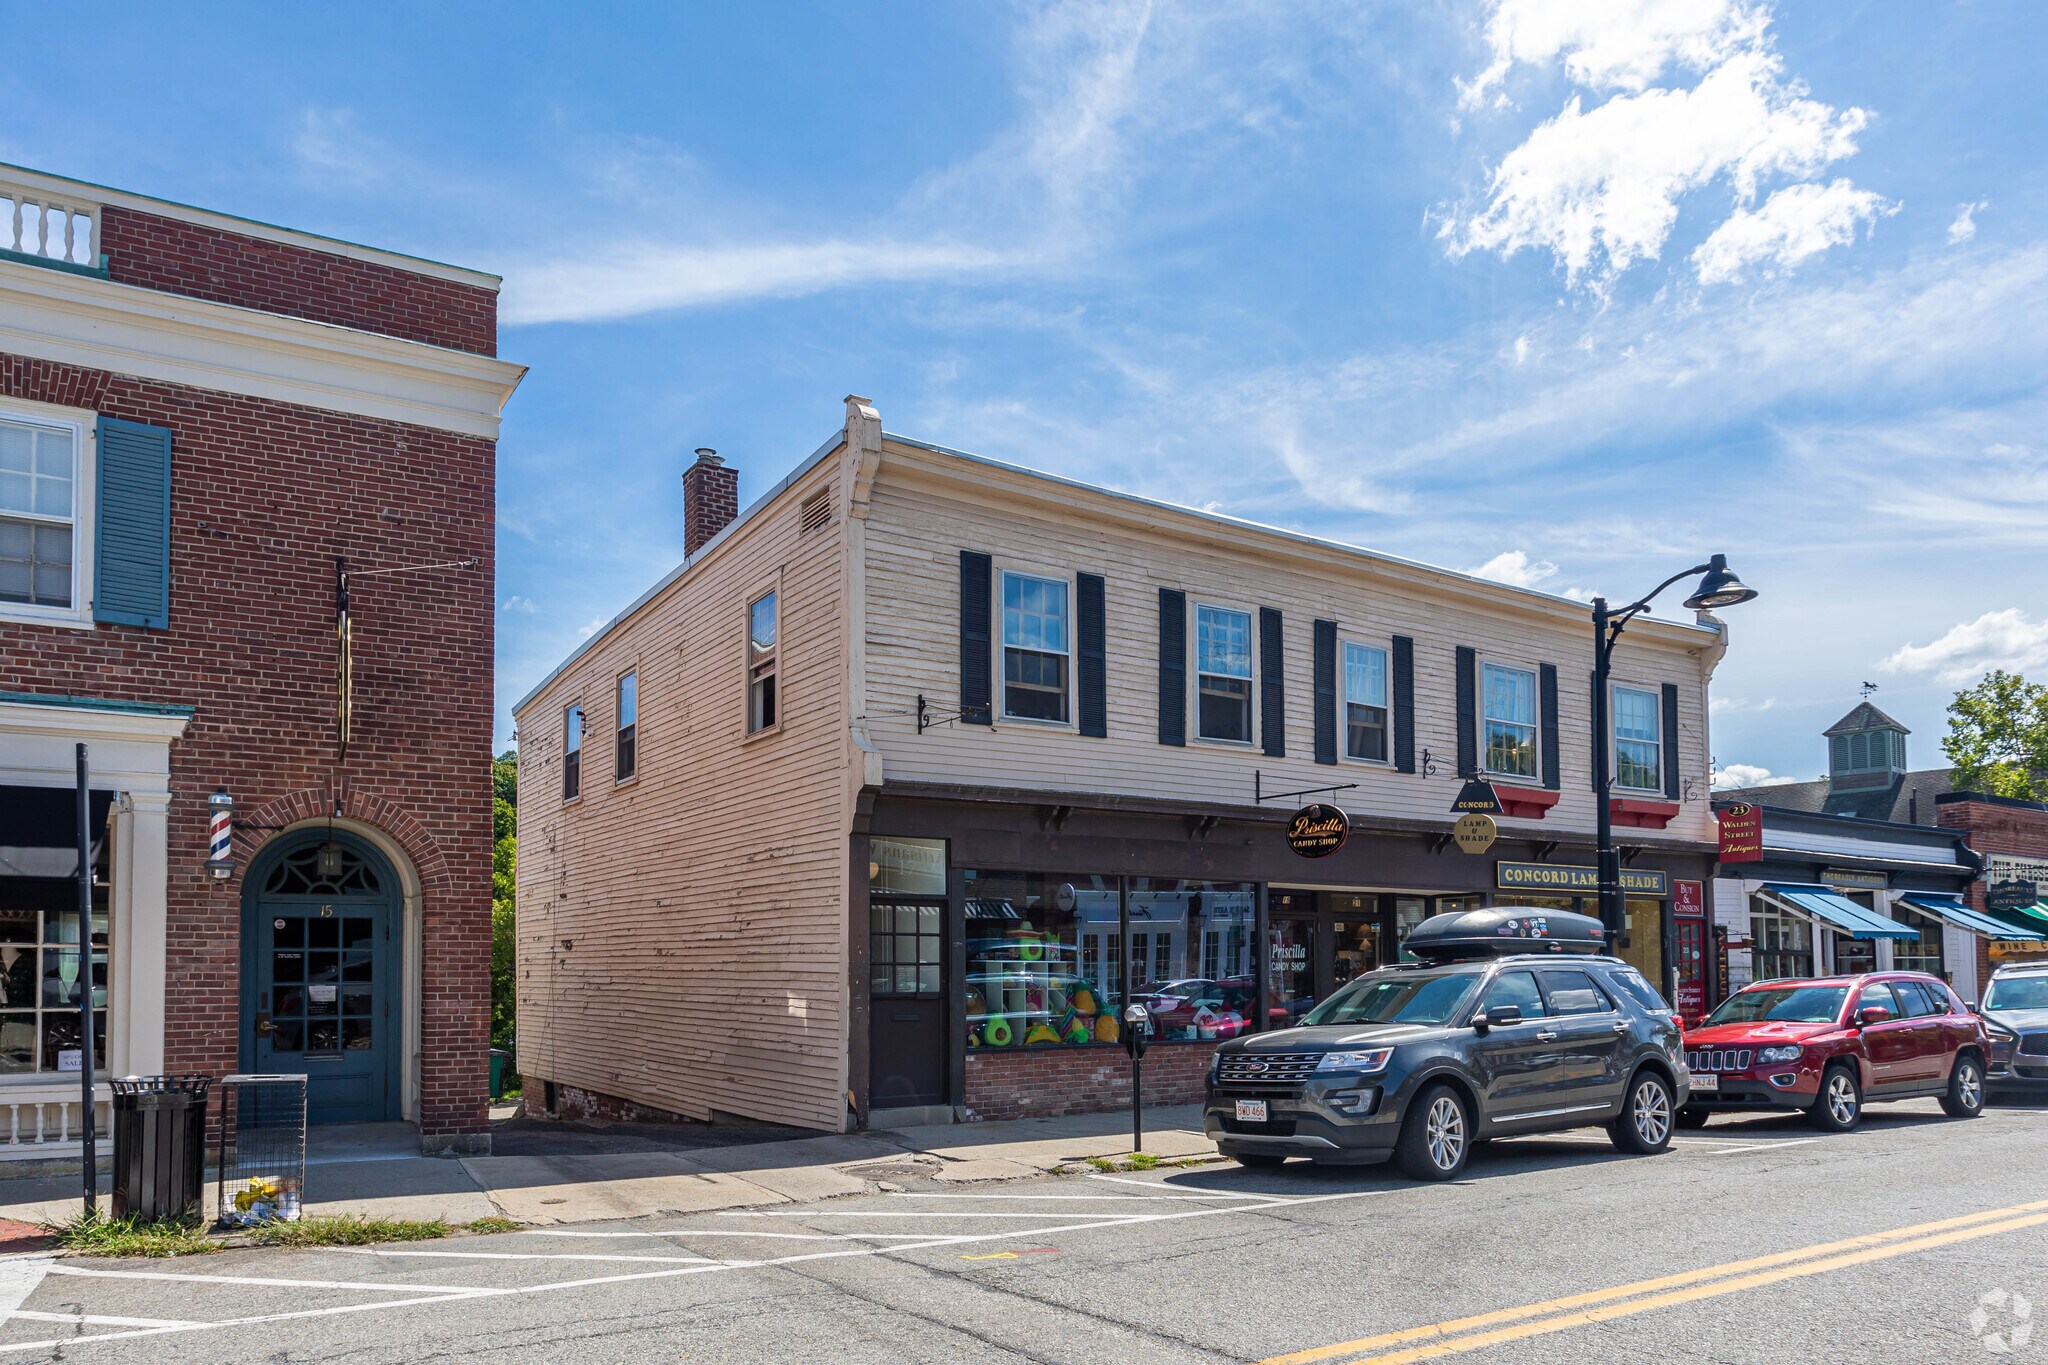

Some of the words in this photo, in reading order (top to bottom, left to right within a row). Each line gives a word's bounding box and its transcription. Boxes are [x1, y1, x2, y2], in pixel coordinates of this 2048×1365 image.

[1458, 801, 1494, 809] CONCORD
[1732, 806, 1745, 815] 23
[1289, 815, 1343, 838] Priscilla
[1722, 820, 1757, 829] WALDEN
[1471, 827, 1478, 835] &
[1724, 831, 1755, 839] STREET
[1293, 839, 1318, 848] CANDY
[1318, 838, 1338, 846] SHOP
[1460, 834, 1489, 842] SHADE
[1720, 843, 1759, 854] Antiques
[1504, 868, 1569, 884] CONCORD
[1571, 871, 1598, 886] LAM
[1619, 875, 1659, 889] SHADE
[1680, 883, 1693, 894] BUY
[1682, 893, 1691, 904] &
[320, 904, 333, 918] 15
[1673, 901, 1700, 913] CONSIGN
[1271, 943, 1306, 959] Priscilla
[1683, 946, 1690, 954] 23
[1999, 942, 2027, 951] WINE
[1271, 962, 1290, 971] CANDY
[1290, 961, 1306, 971] SHOP
[1252, 1106, 1264, 1116] 466
